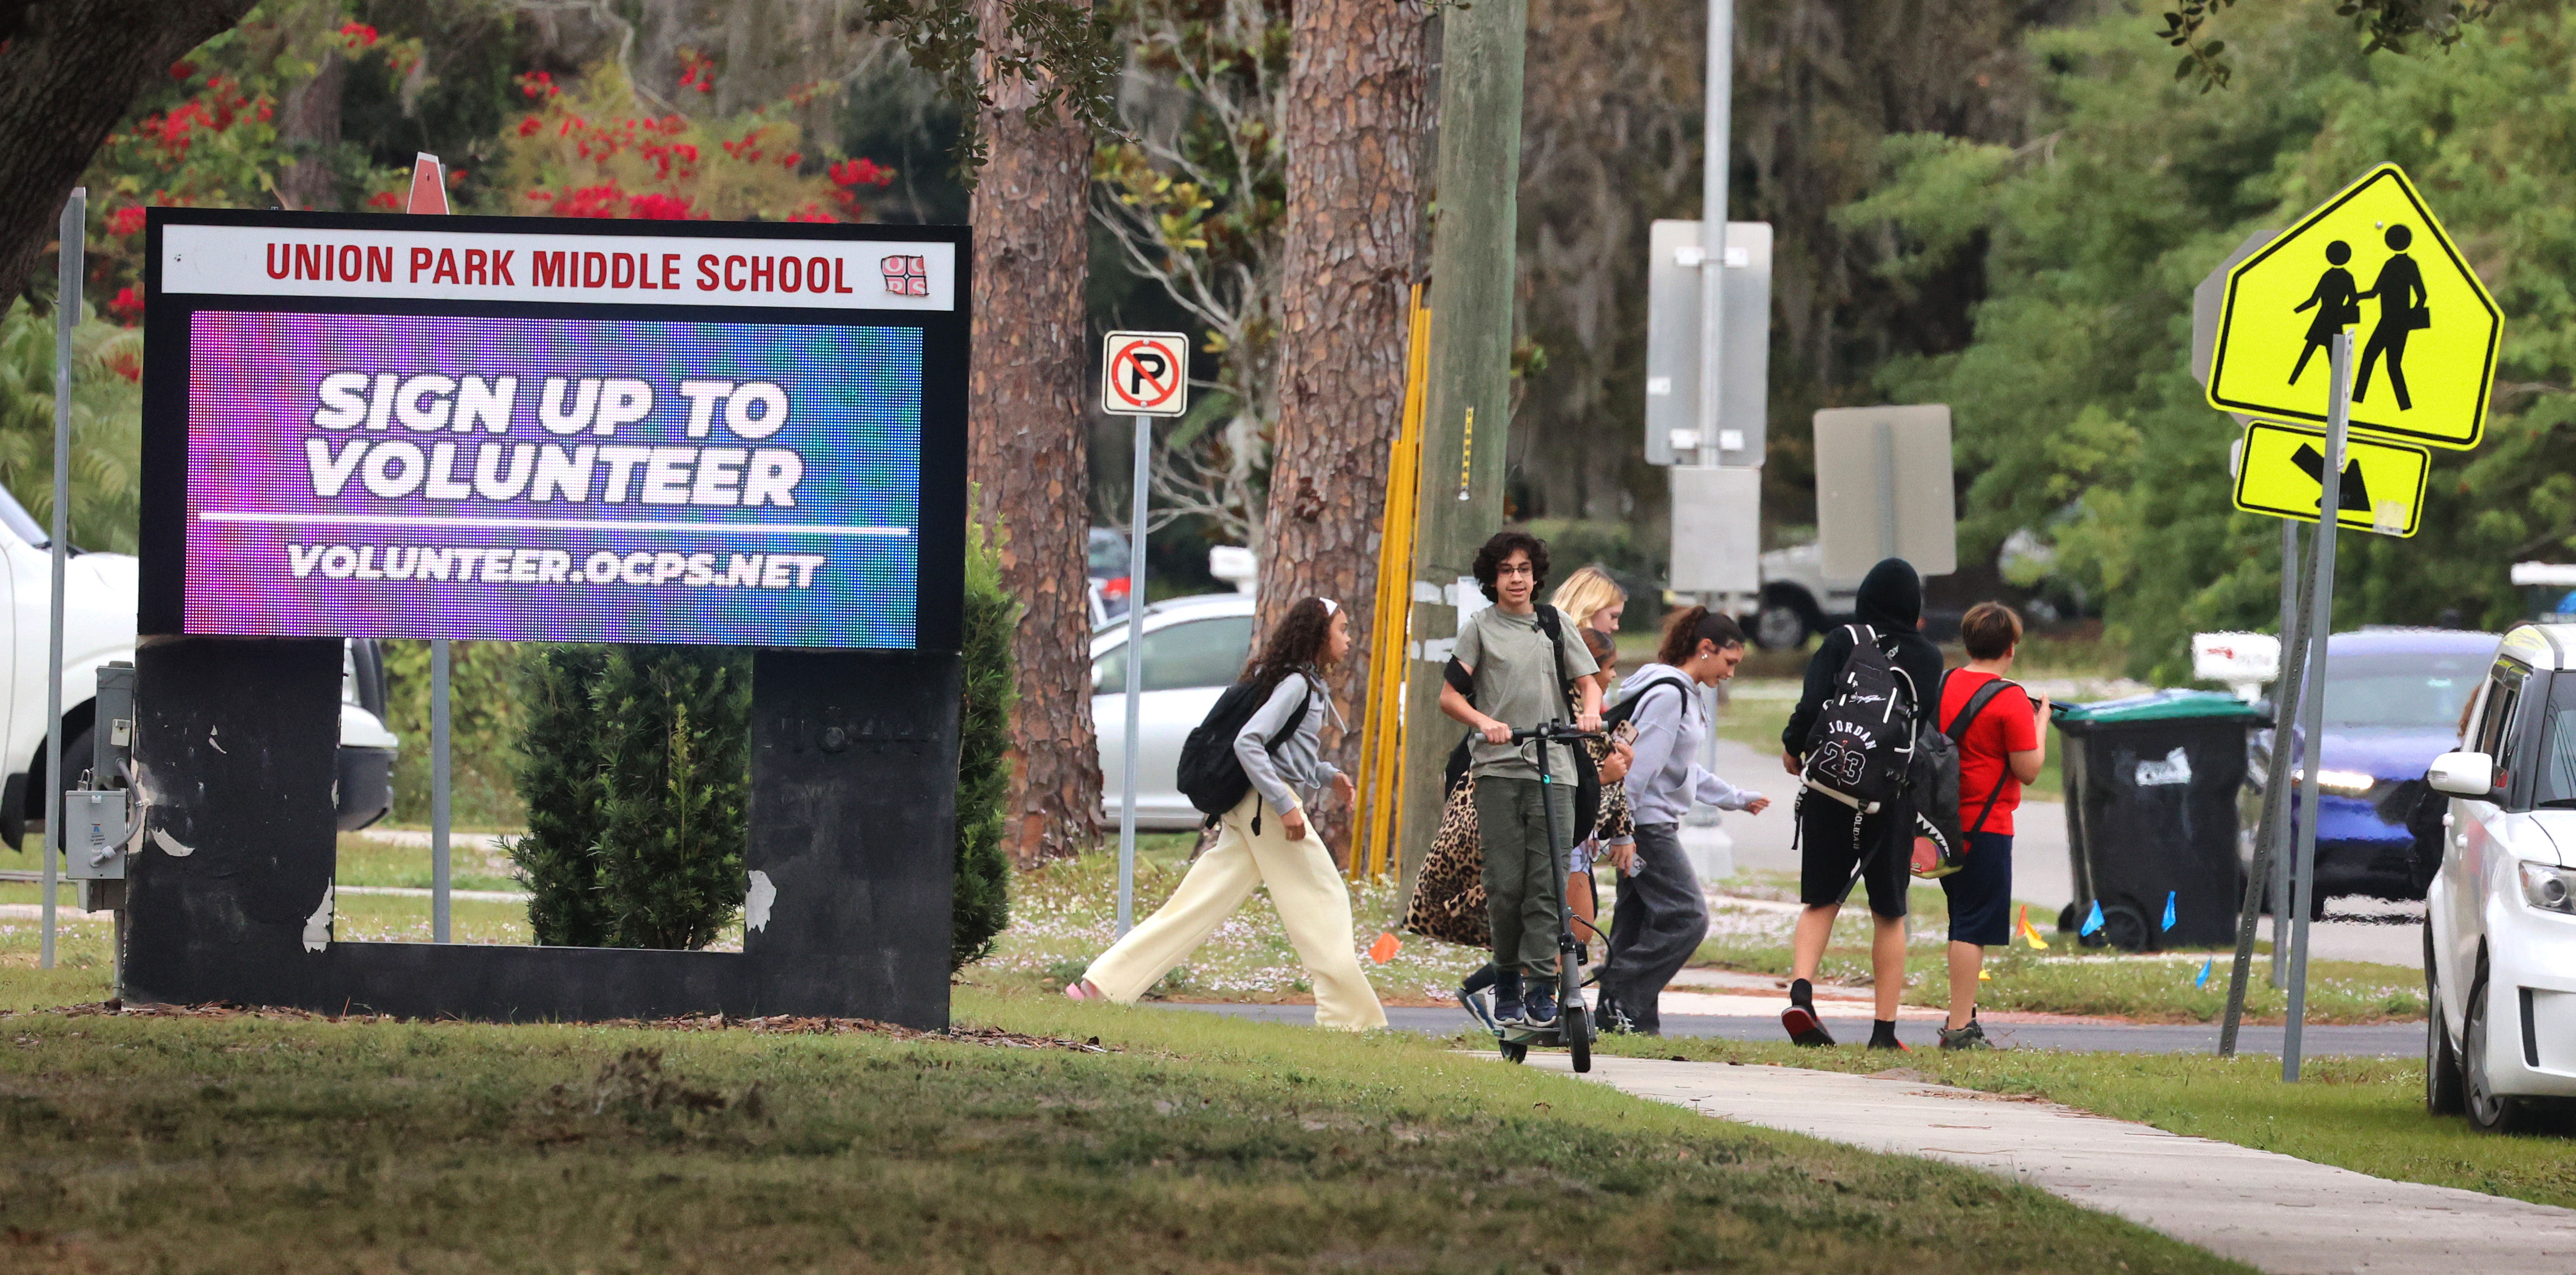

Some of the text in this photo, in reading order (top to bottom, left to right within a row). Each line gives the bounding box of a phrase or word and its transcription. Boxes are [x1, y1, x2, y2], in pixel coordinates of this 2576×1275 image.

[267, 243, 852, 293] UNION PARK MIDDLE SCHOOL
[314, 372, 789, 439] SIGN UP TO
[306, 440, 804, 506] VOLUNTEER
[288, 544, 824, 588] VOLUNTEER.OCPS.NET
[1828, 719, 1878, 750] JORDAN
[1819, 741, 1866, 785] 23
